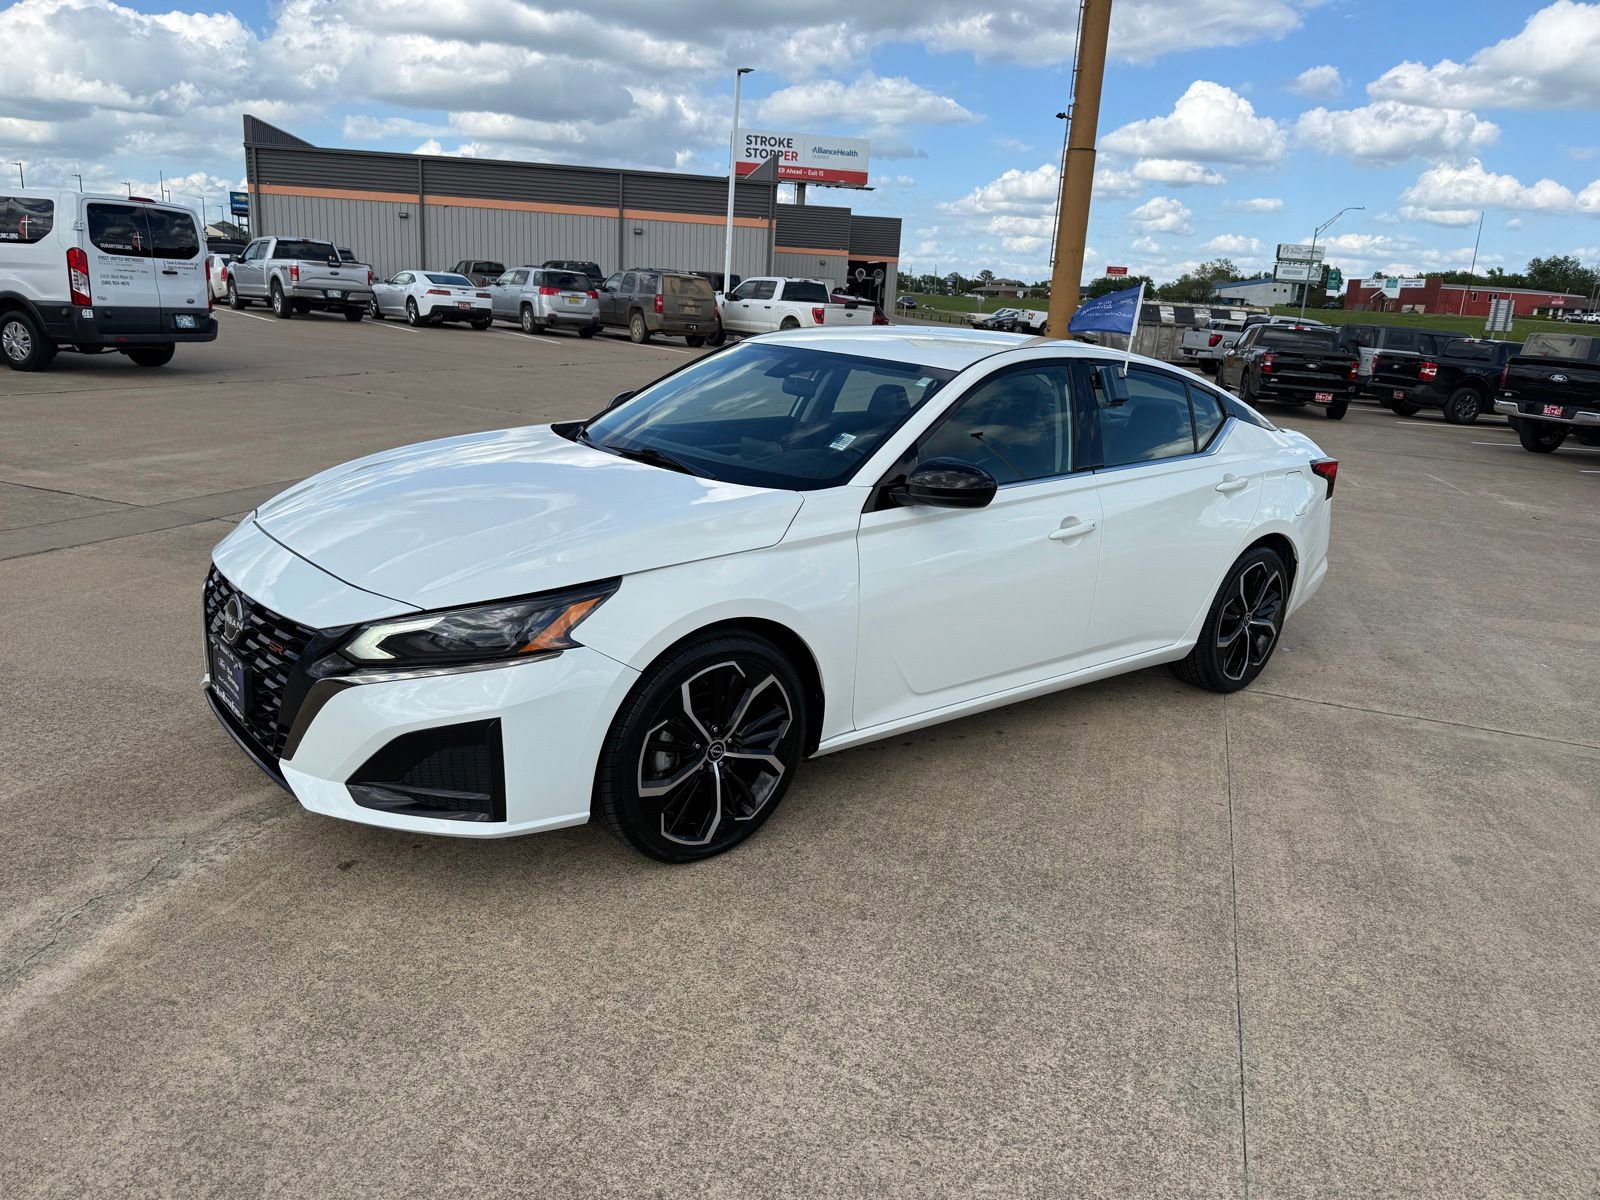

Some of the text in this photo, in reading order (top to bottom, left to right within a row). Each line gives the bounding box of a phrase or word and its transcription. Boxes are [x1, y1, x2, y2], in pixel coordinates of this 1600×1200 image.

[746, 134, 793, 148] STROKE
[745, 147, 798, 161] STOPPER
[812, 146, 858, 158] AllianceHealth
[268, 640, 285, 655] SR
